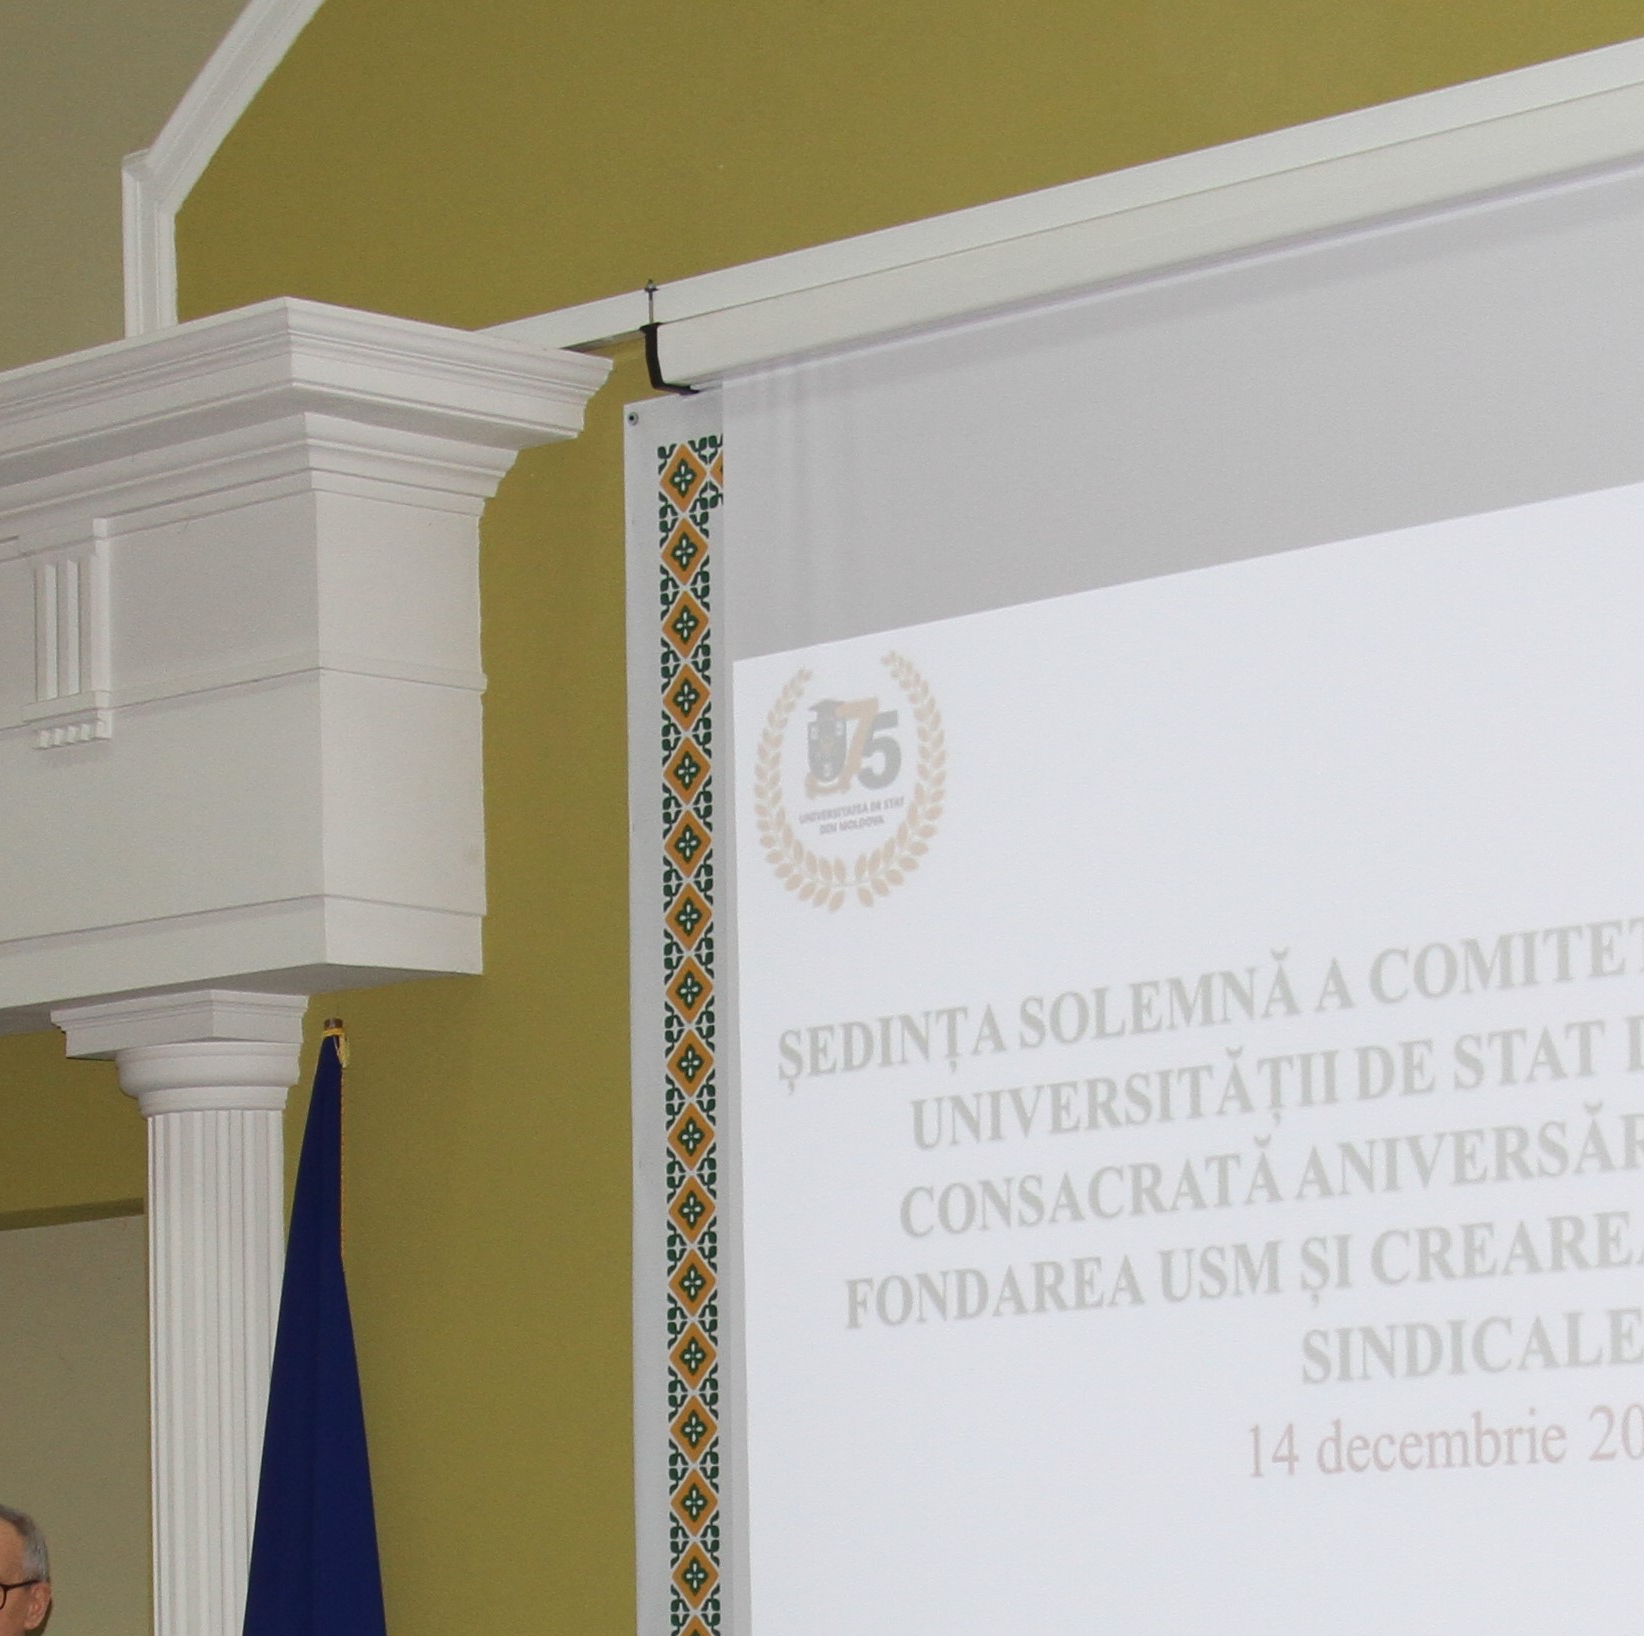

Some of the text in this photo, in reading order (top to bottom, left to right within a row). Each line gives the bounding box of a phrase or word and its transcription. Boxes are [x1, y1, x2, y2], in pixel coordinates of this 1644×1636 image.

[1018, 947, 1301, 1051] SOLEMNĂ
[1314, 957, 1356, 1014] A
[1353, 1037, 1437, 1102] DE
[1452, 1018, 1607, 1092] STAT
[898, 1133, 1285, 1241] CONSACRATĂ
[844, 1254, 1147, 1331] FONDAREA
[1157, 1239, 1283, 1305] USM
[1248, 1421, 1301, 1480] 14
[1315, 1406, 1568, 1477] decembrie
